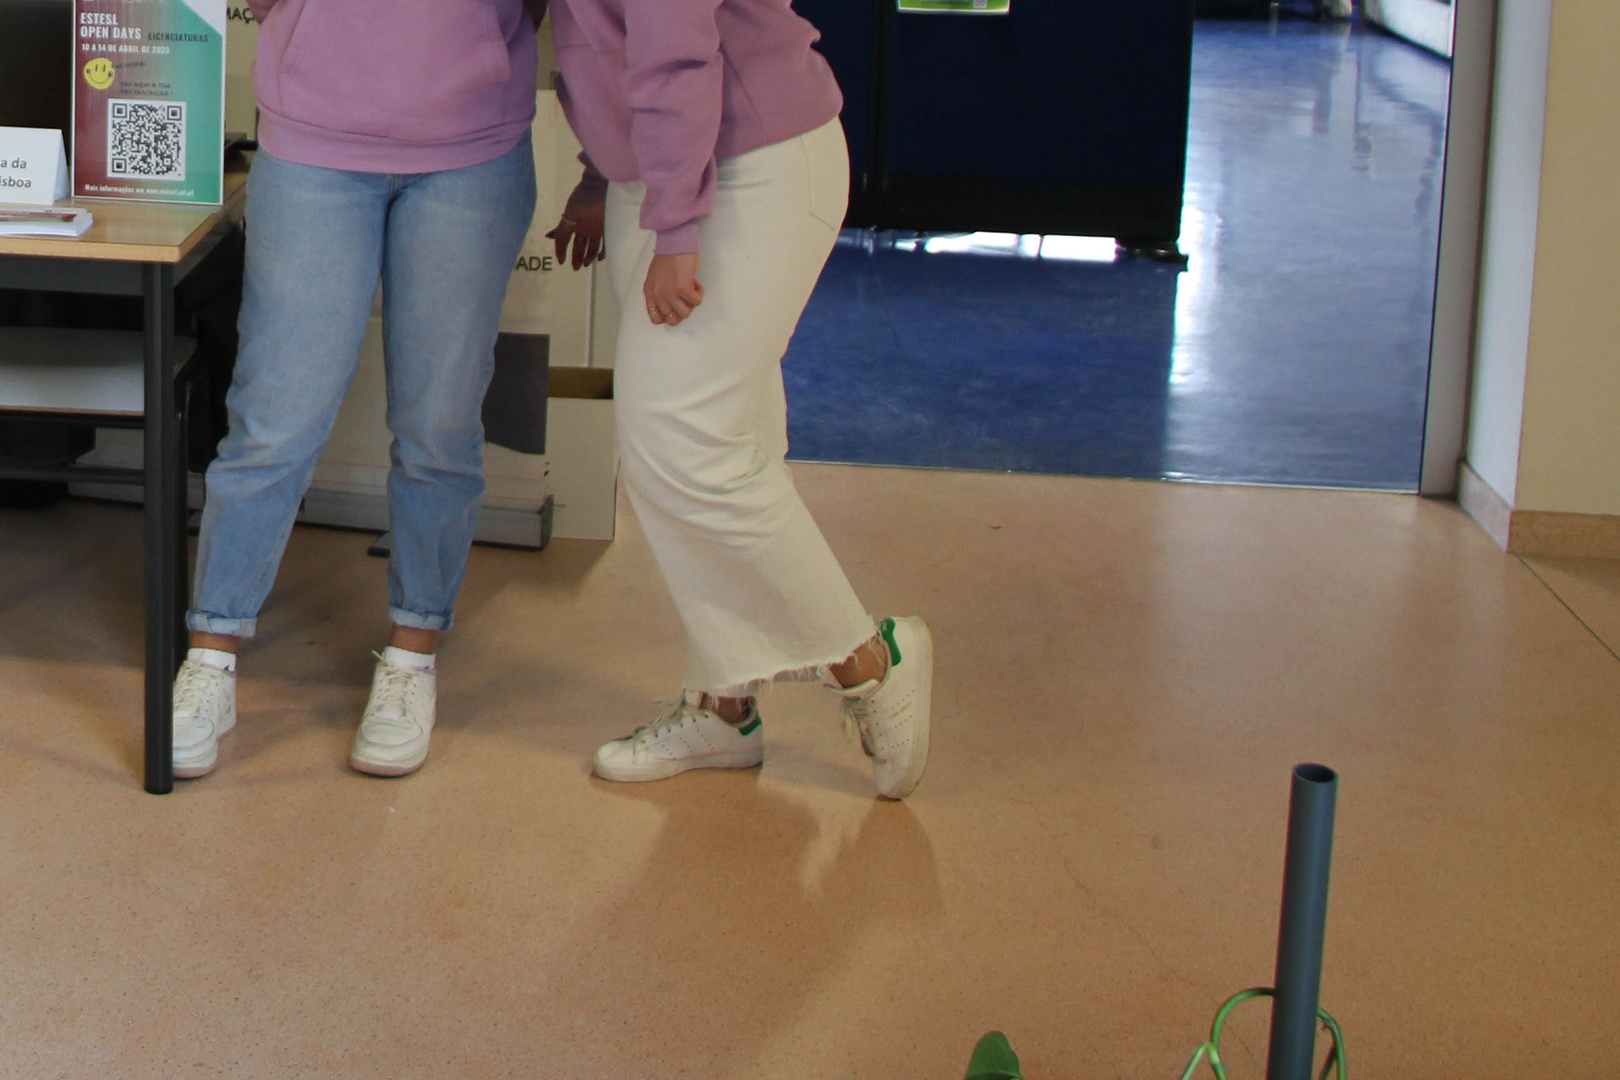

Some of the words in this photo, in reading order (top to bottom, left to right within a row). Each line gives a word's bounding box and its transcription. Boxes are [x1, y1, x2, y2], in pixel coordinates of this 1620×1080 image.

[80, 12, 118, 25] ESTESL
[80, 25, 109, 38] OPEN
[113, 27, 141, 40] DAYS
[148, 32, 209, 42] LICENCIATURAS
[82, 43, 89, 51] 10
[98, 44, 106, 52] 14
[119, 45, 139, 53] ABRIL
[11, 157, 27, 169] da
